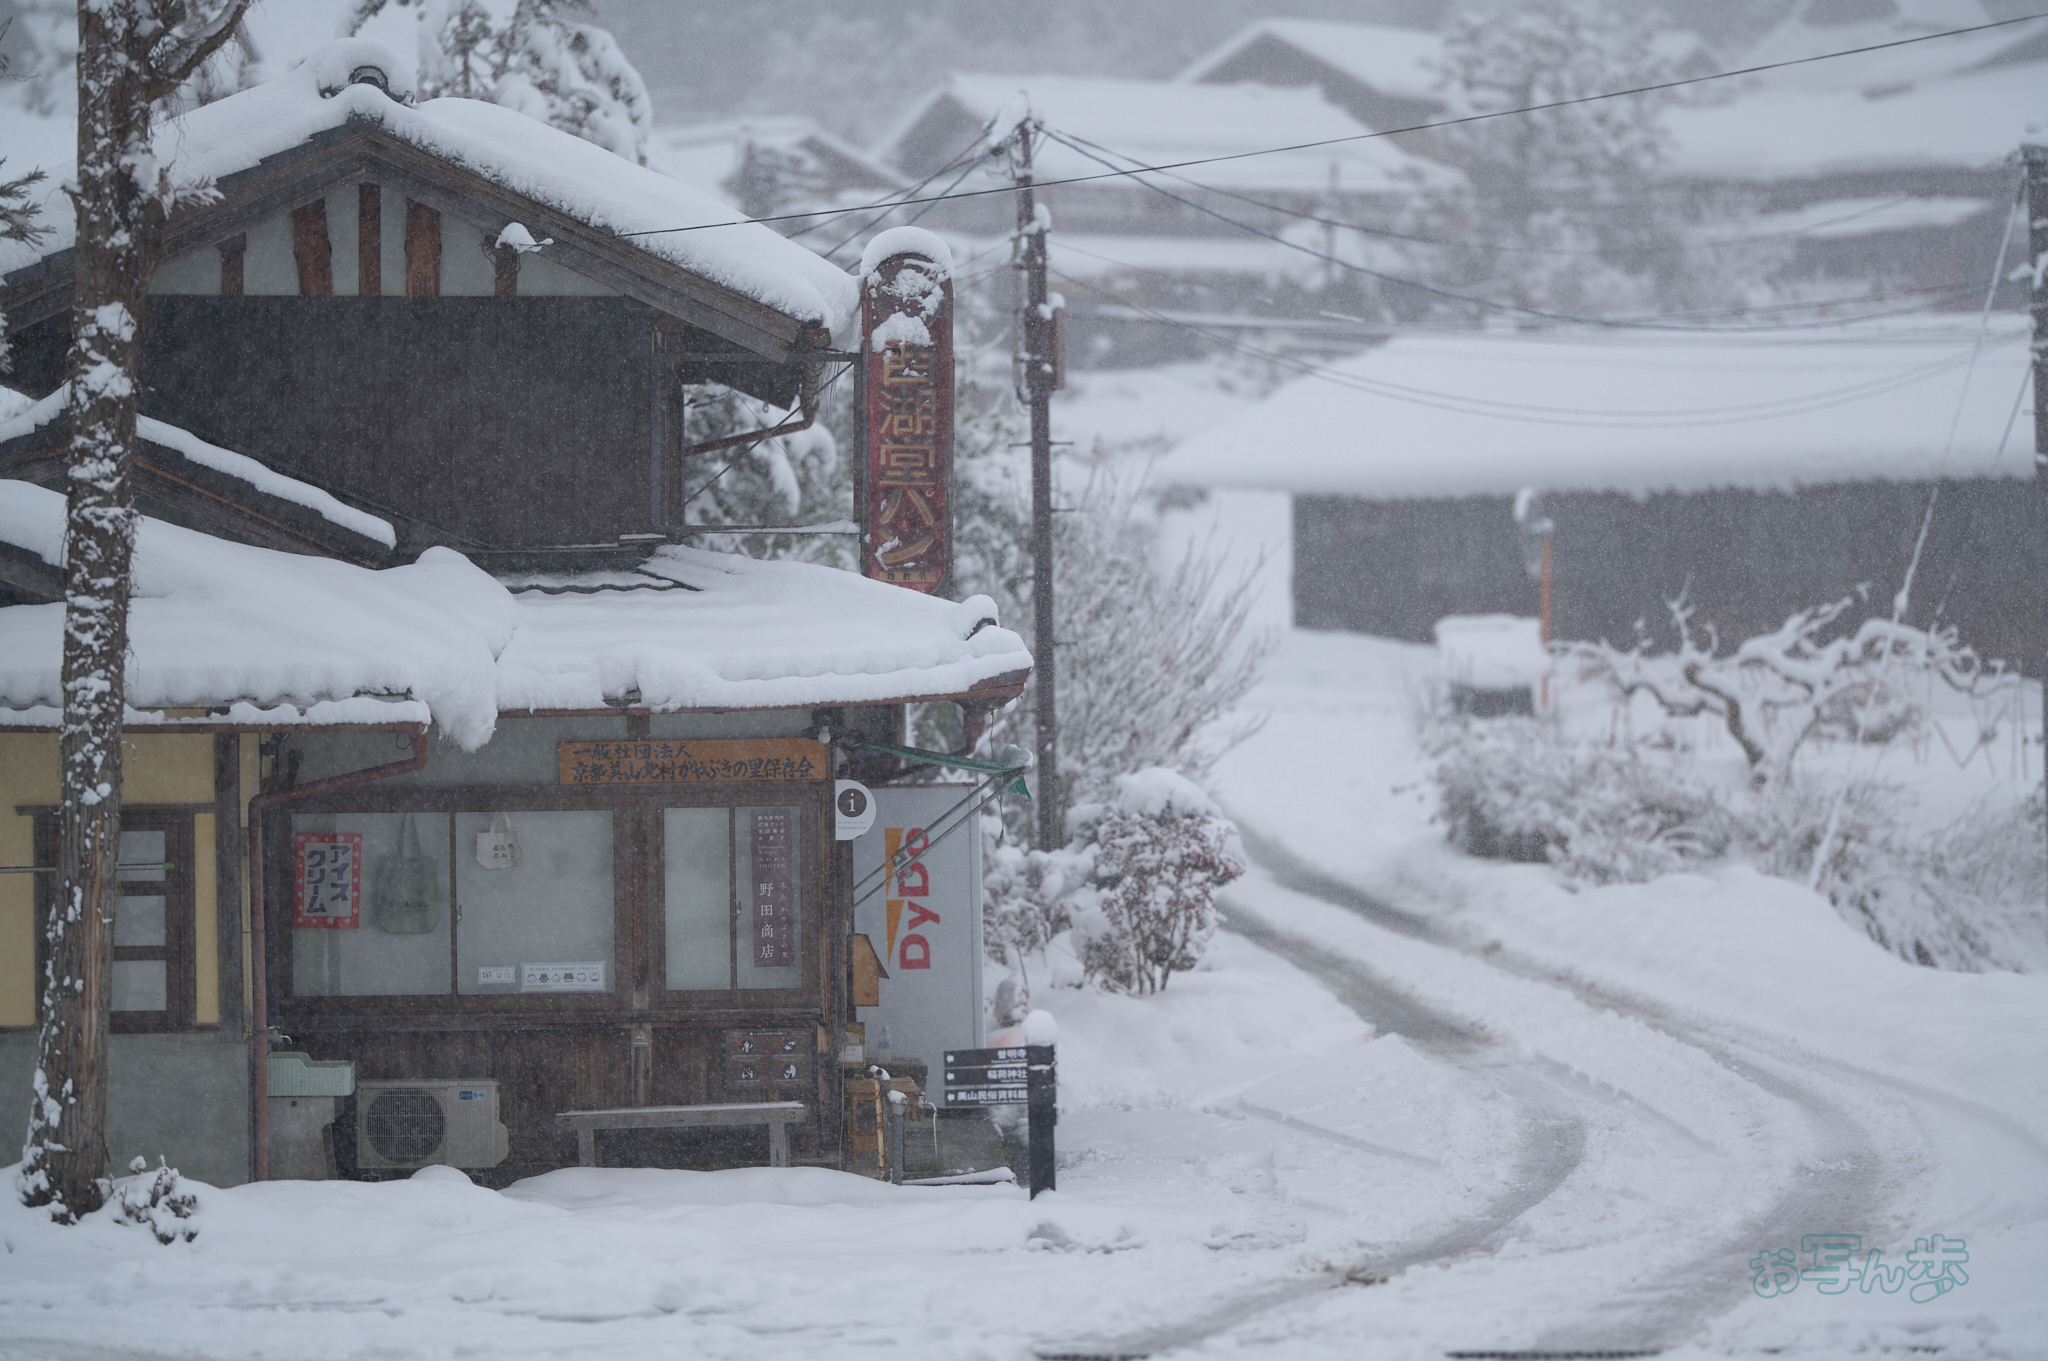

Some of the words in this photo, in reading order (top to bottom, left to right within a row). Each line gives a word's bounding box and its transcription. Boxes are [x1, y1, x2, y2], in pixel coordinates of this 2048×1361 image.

[572, 743, 694, 761] 一般社団法人
[306, 851, 326, 913] クリーム
[330, 845, 350, 901] アイス
[759, 882, 774, 959] 野田商店
[987, 1069, 1028, 1080] 稲荷神社
[957, 1089, 1028, 1101] 美山民俗資料館
